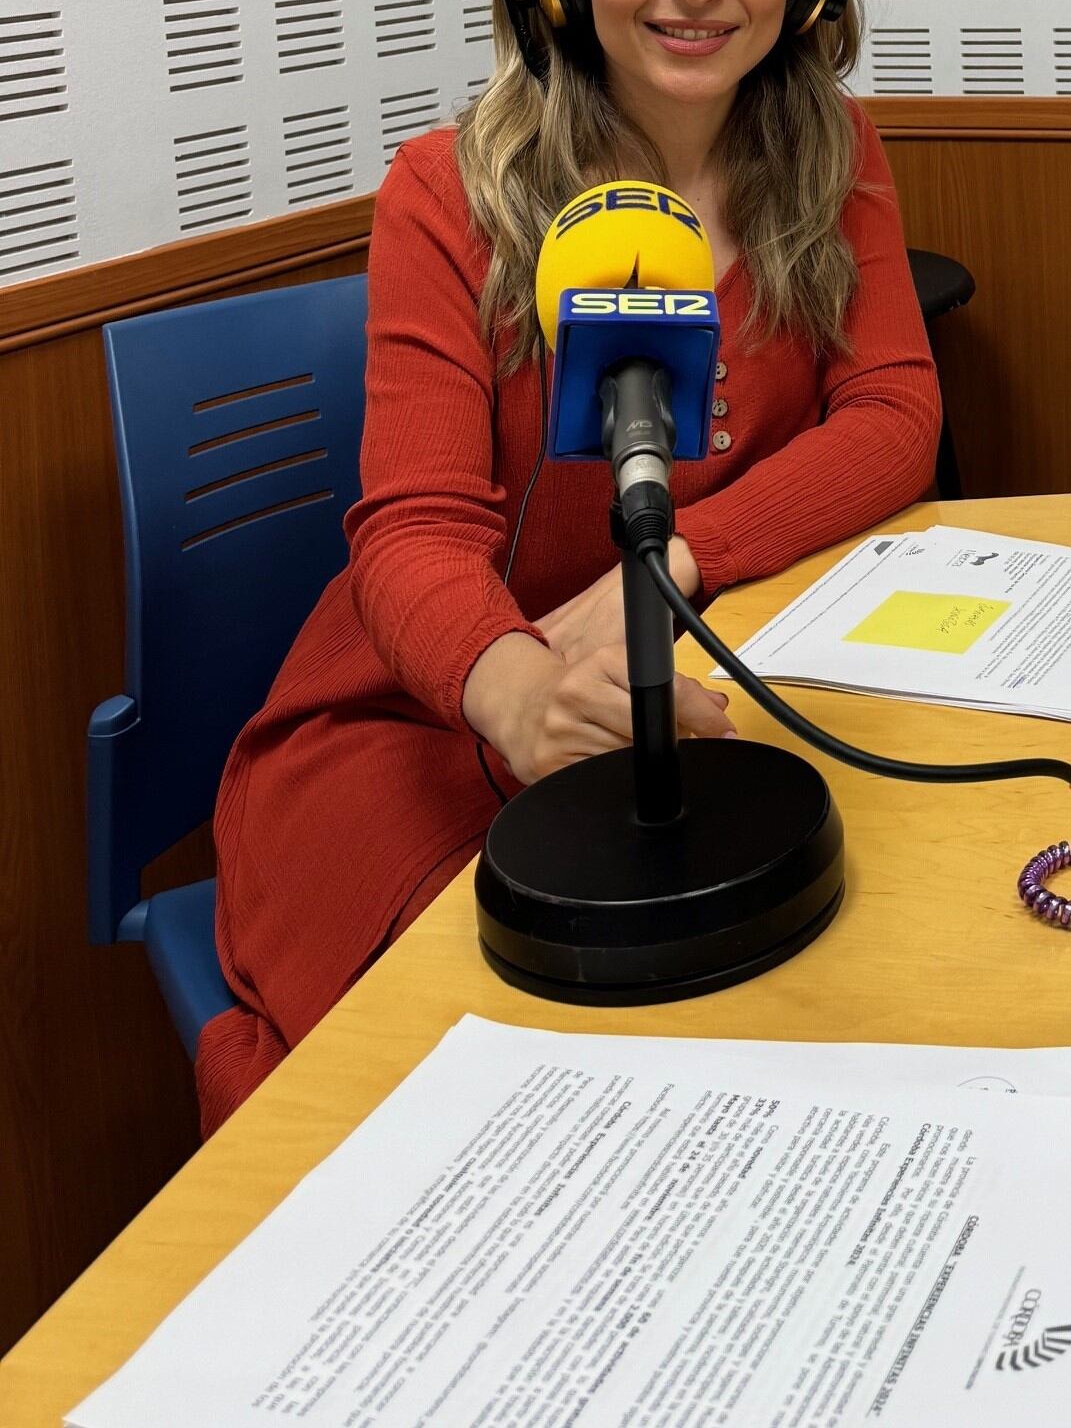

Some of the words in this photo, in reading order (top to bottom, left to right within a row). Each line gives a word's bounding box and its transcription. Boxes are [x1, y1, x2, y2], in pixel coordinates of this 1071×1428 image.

[556, 188, 703, 240] SER
[571, 293, 711, 315] SER
[907, 1123, 932, 1155] Córdoba
[877, 1156, 914, 1206] Experiencias
[859, 1207, 886, 1242] Infinitas
[844, 1243, 865, 1268] 2024.
[1003, 1288, 1041, 1348] CÓRDOBA
